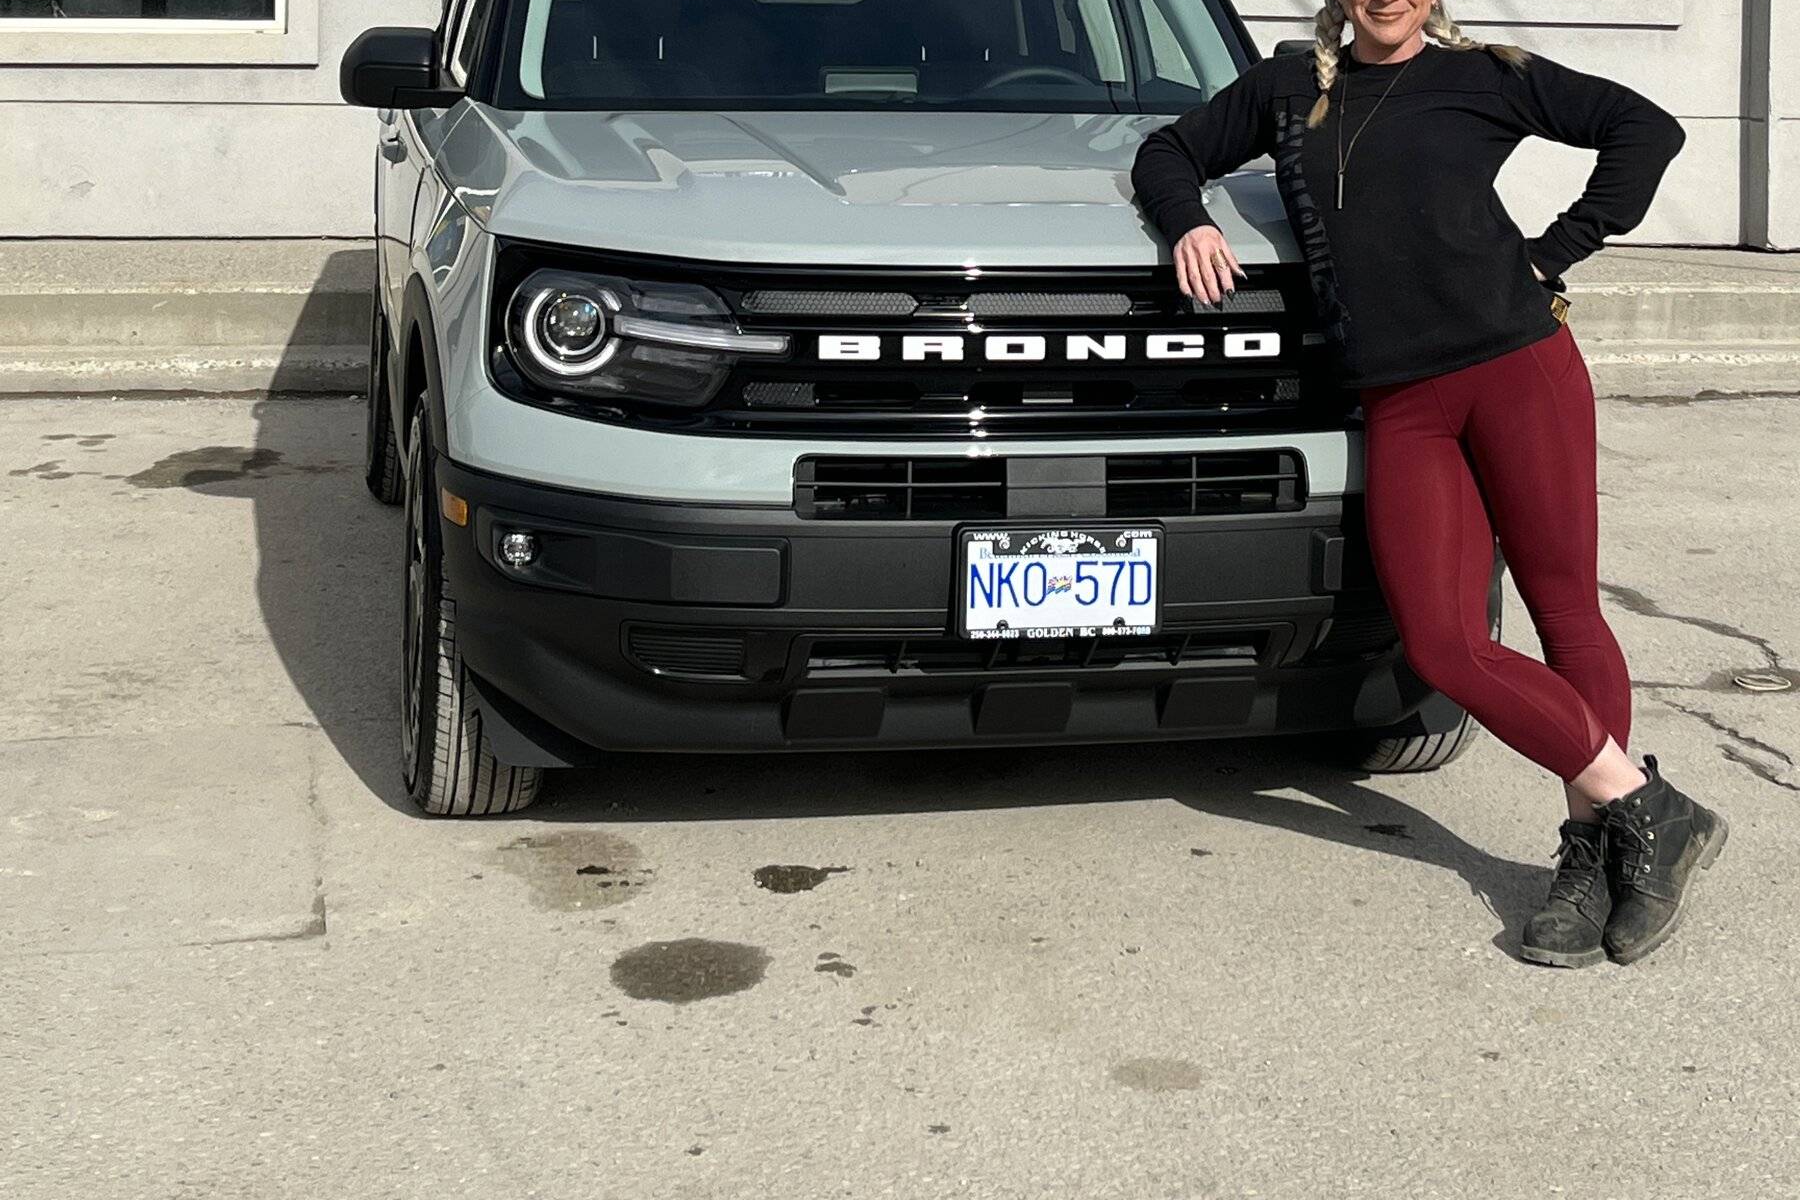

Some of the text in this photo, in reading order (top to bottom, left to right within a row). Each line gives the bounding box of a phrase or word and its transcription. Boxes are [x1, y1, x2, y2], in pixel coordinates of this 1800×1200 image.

[817, 332, 1282, 361] BRONCO
[1075, 560, 1152, 607] 57D
[1026, 627, 1075, 639] GOLDEN
[1079, 626, 1096, 638] BC
